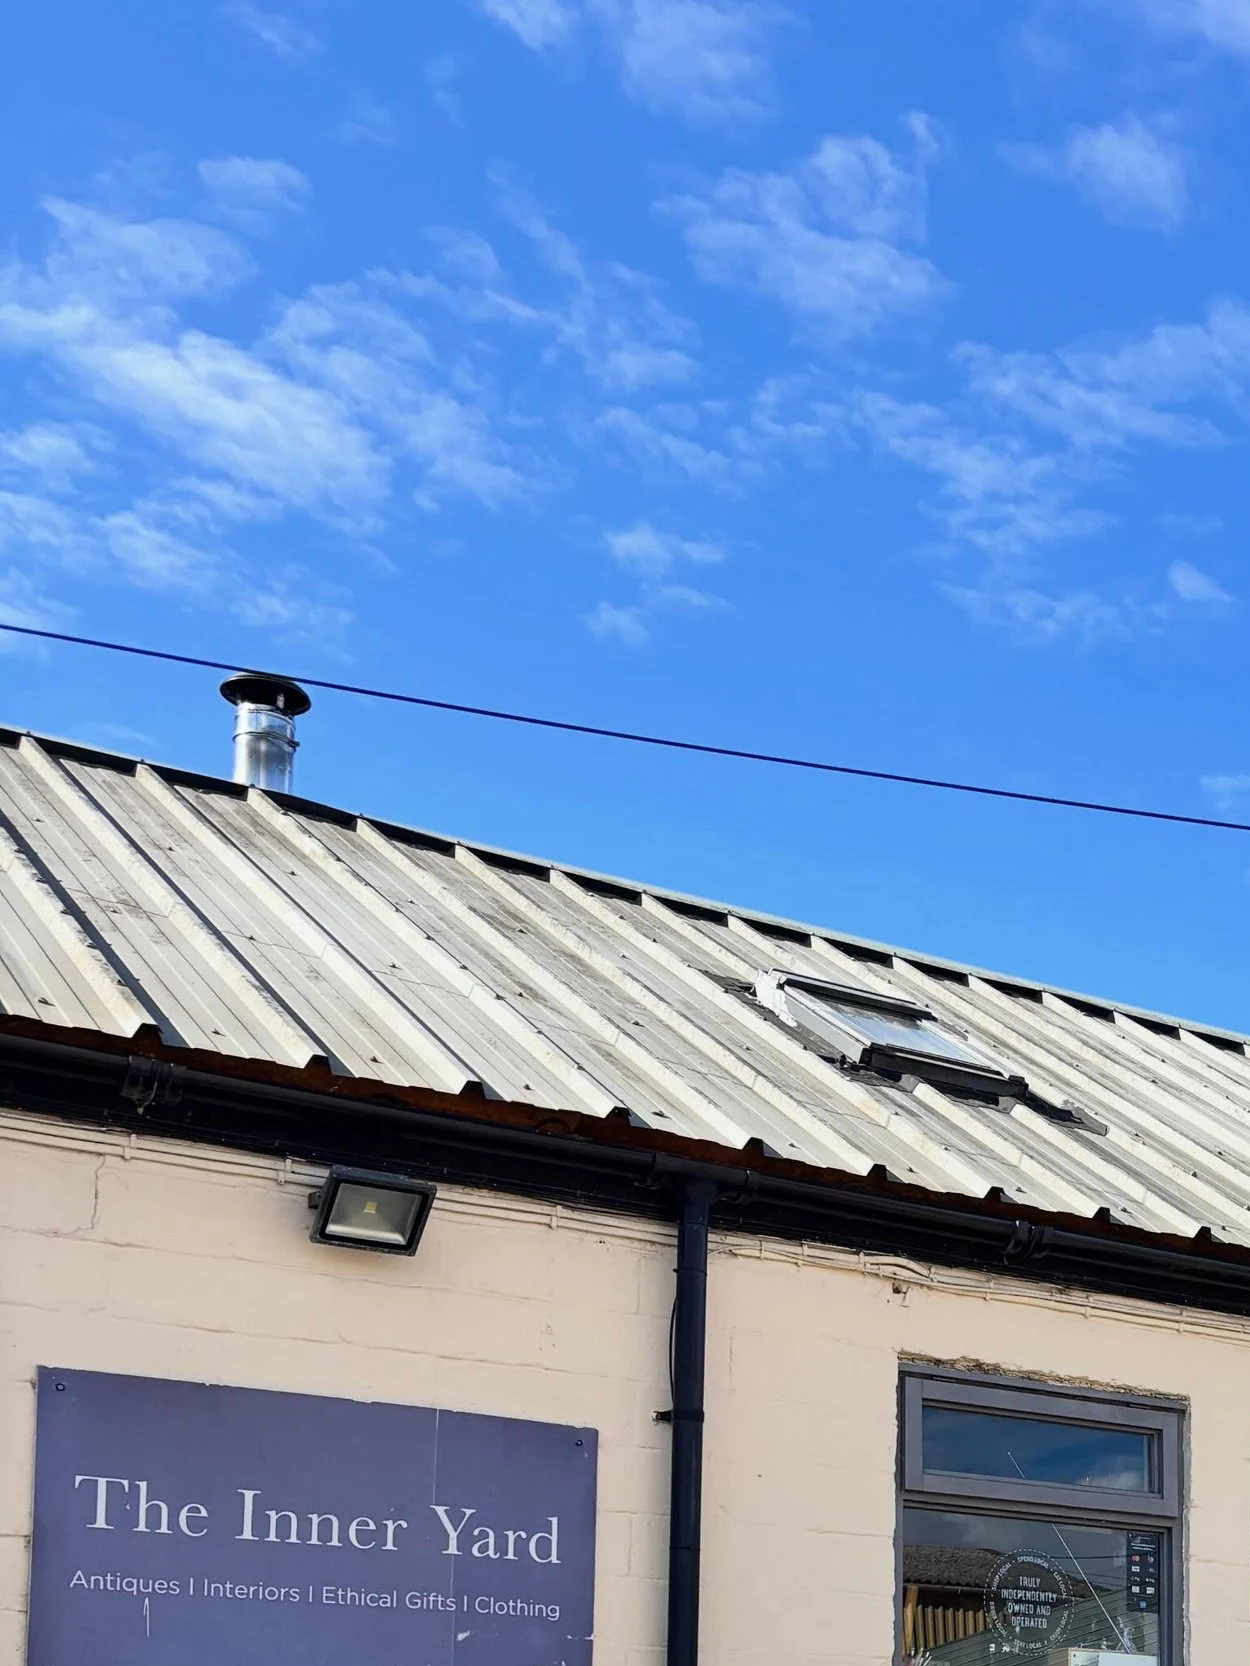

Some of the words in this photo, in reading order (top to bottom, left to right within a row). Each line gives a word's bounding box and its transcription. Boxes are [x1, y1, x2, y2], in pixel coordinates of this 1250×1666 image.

[74, 1474, 209, 1537] The
[234, 1488, 408, 1551] Inner
[429, 1504, 562, 1564] Yard
[998, 1562, 1012, 1576] LOCAL
[1034, 1557, 1049, 1569] LOCAL
[1019, 1576, 1041, 1587] TRULY
[69, 1569, 181, 1596] Antiques
[203, 1578, 301, 1602] Interiors
[322, 1586, 397, 1608] Ethical
[405, 1591, 457, 1611] Gifts
[474, 1596, 560, 1621] Clothing
[1001, 1589, 1057, 1603] INDEPENDENTLY
[1007, 1602, 1034, 1615] OWNED
[1035, 1605, 1051, 1616] AND
[1011, 1616, 1048, 1629] OPERATED
[1026, 1641, 1042, 1649] LOCAL
